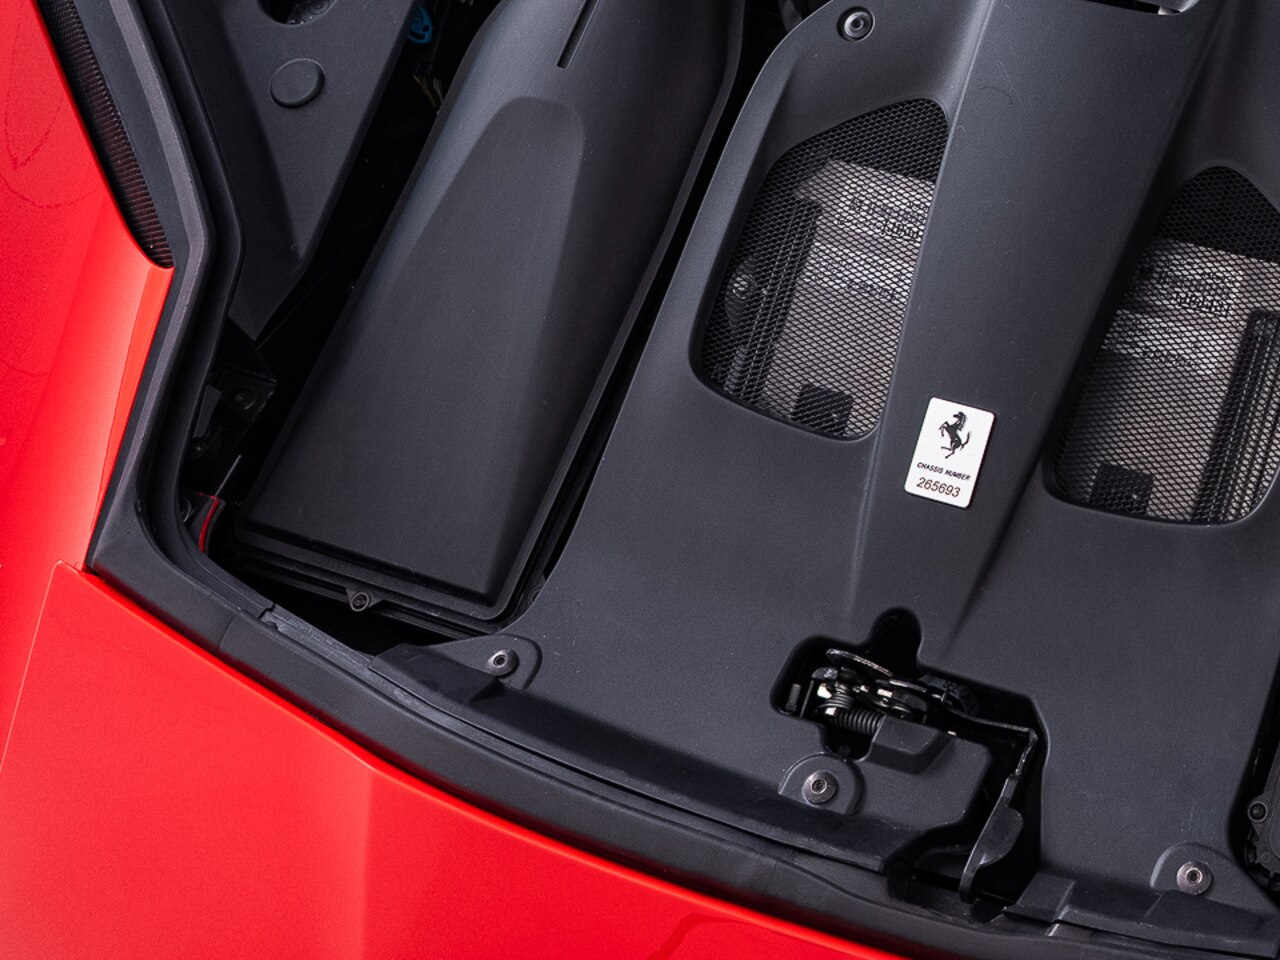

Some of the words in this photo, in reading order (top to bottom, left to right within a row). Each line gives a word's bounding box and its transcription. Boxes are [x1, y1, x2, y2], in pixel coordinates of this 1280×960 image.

[917, 462, 943, 474] CHASSIS
[945, 469, 971, 480] NUMBER
[916, 476, 961, 497] 265693
